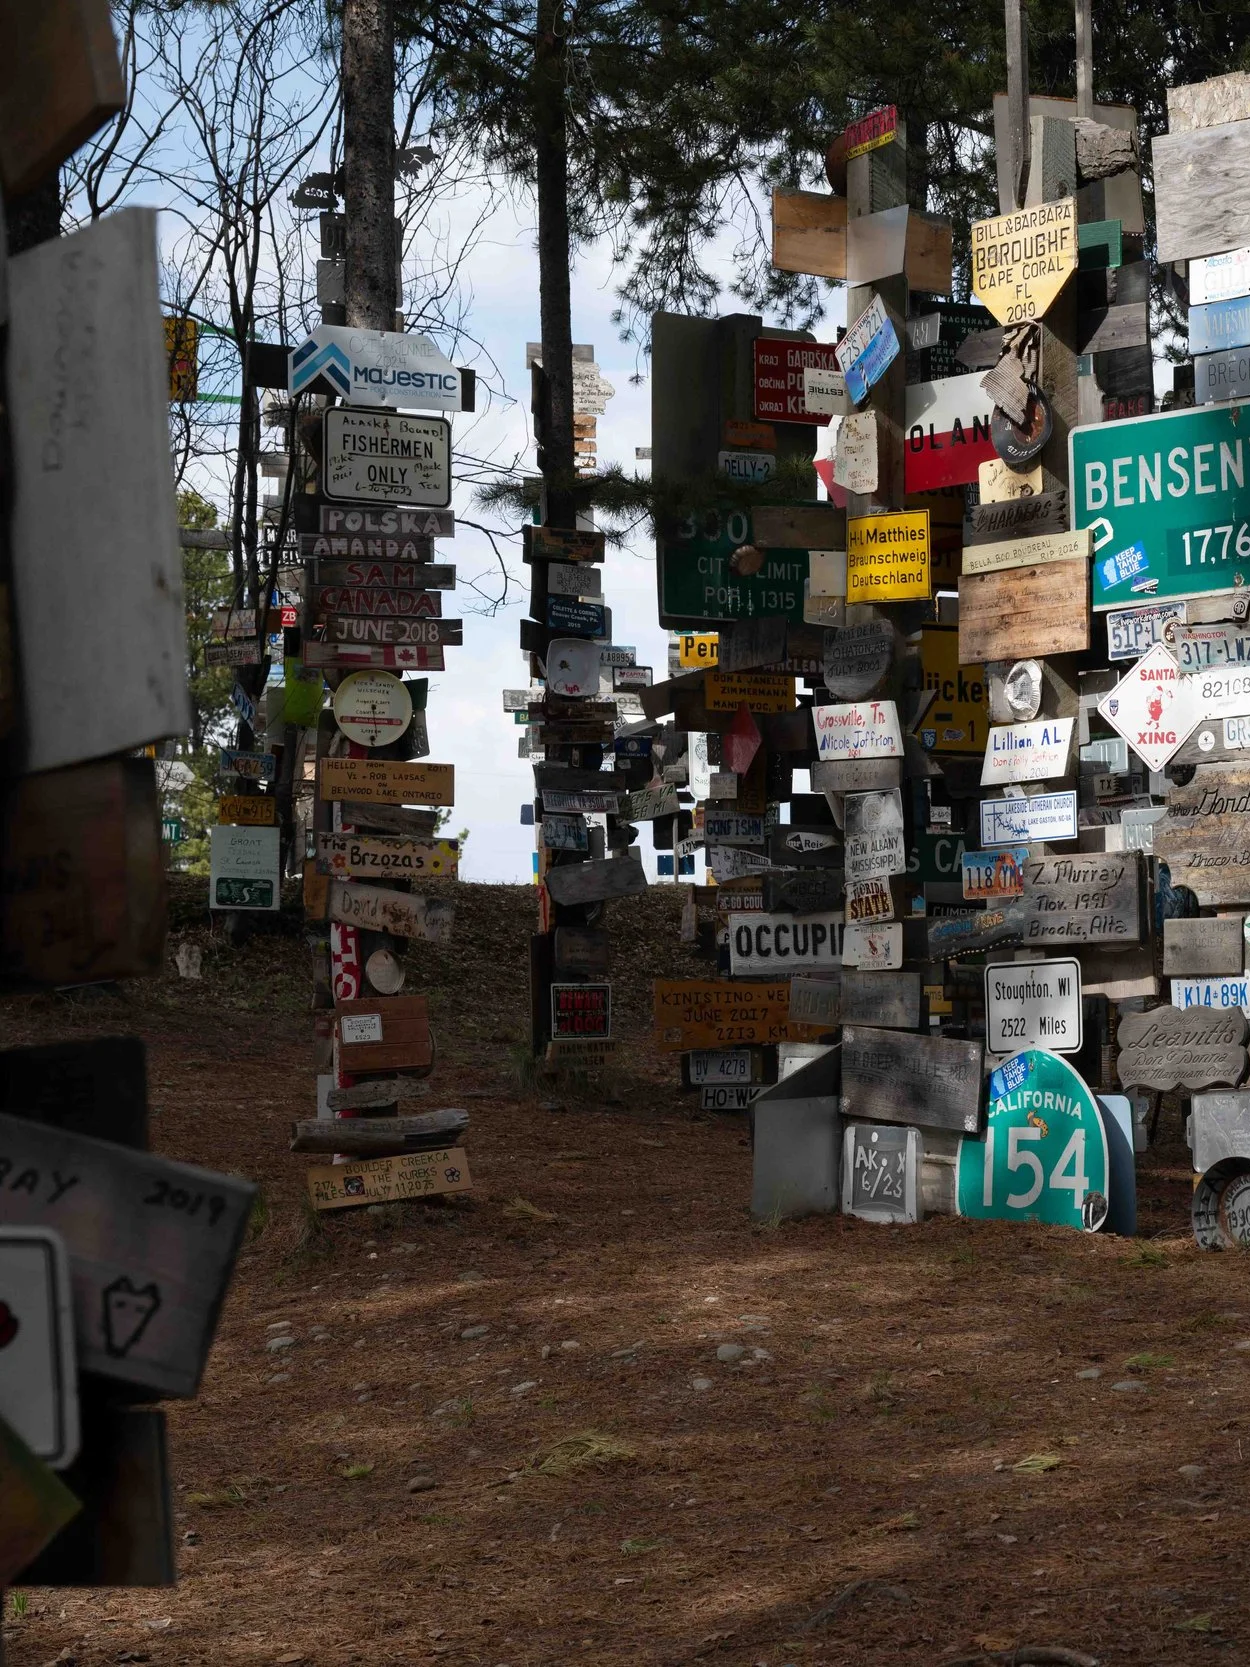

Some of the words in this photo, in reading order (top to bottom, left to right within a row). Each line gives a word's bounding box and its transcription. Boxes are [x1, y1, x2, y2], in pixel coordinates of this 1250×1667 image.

[979, 270, 1014, 291] CAPE
[1022, 262, 1064, 281] CORAL
[1016, 285, 1032, 299] FL
[342, 434, 433, 459] FISHERMEN
[368, 465, 407, 484] ONLY
[328, 510, 441, 533] POLSKA
[987, 500, 1053, 532] HARDERS
[866, 527, 925, 544] Matthies
[313, 538, 418, 559] AMANDA
[1115, 545, 1135, 562] KEEP
[849, 550, 927, 568] Braunschweig
[1117, 551, 1143, 570] TAHOE
[347, 563, 414, 586] SAM
[852, 570, 923, 588] Deutschland
[1119, 562, 1141, 578] BLUE
[320, 592, 440, 616] CANADA
[761, 591, 796, 610] 1315
[336, 618, 396, 643] JUNE
[399, 622, 440, 643] 2018
[1181, 631, 1227, 640] WASHINGTON
[1140, 668, 1175, 681] SANTA
[720, 686, 788, 697] ZIMMERMANN
[1137, 731, 1176, 745] XING
[331, 786, 373, 796] BELWOOD
[376, 789, 398, 798] LAKE
[402, 791, 443, 800] ONTARIO
[850, 843, 868, 856] NEW
[871, 837, 898, 852] ALBANY
[1054, 860, 1125, 890] Murray
[850, 894, 890, 920] STATE
[1058, 978, 1070, 996] WI
[661, 991, 753, 1005] KINISTINO
[683, 1009, 722, 1022] JUNE
[730, 1008, 769, 1021] 2017
[1001, 1018, 1026, 1037] 2522
[1039, 1017, 1066, 1035] Miles
[1128, 1015, 1235, 1049] Leavitts
[719, 1058, 746, 1075] 4278
[1003, 1058, 1020, 1074] KEEP
[1004, 1062, 1027, 1083] TAHOE
[1007, 1073, 1025, 1090] BLUE
[988, 1091, 1082, 1120] CALIFORNIA
[855, 1146, 878, 1171] AK
[982, 1126, 1089, 1209] 154
[372, 1174, 392, 1183] THE
